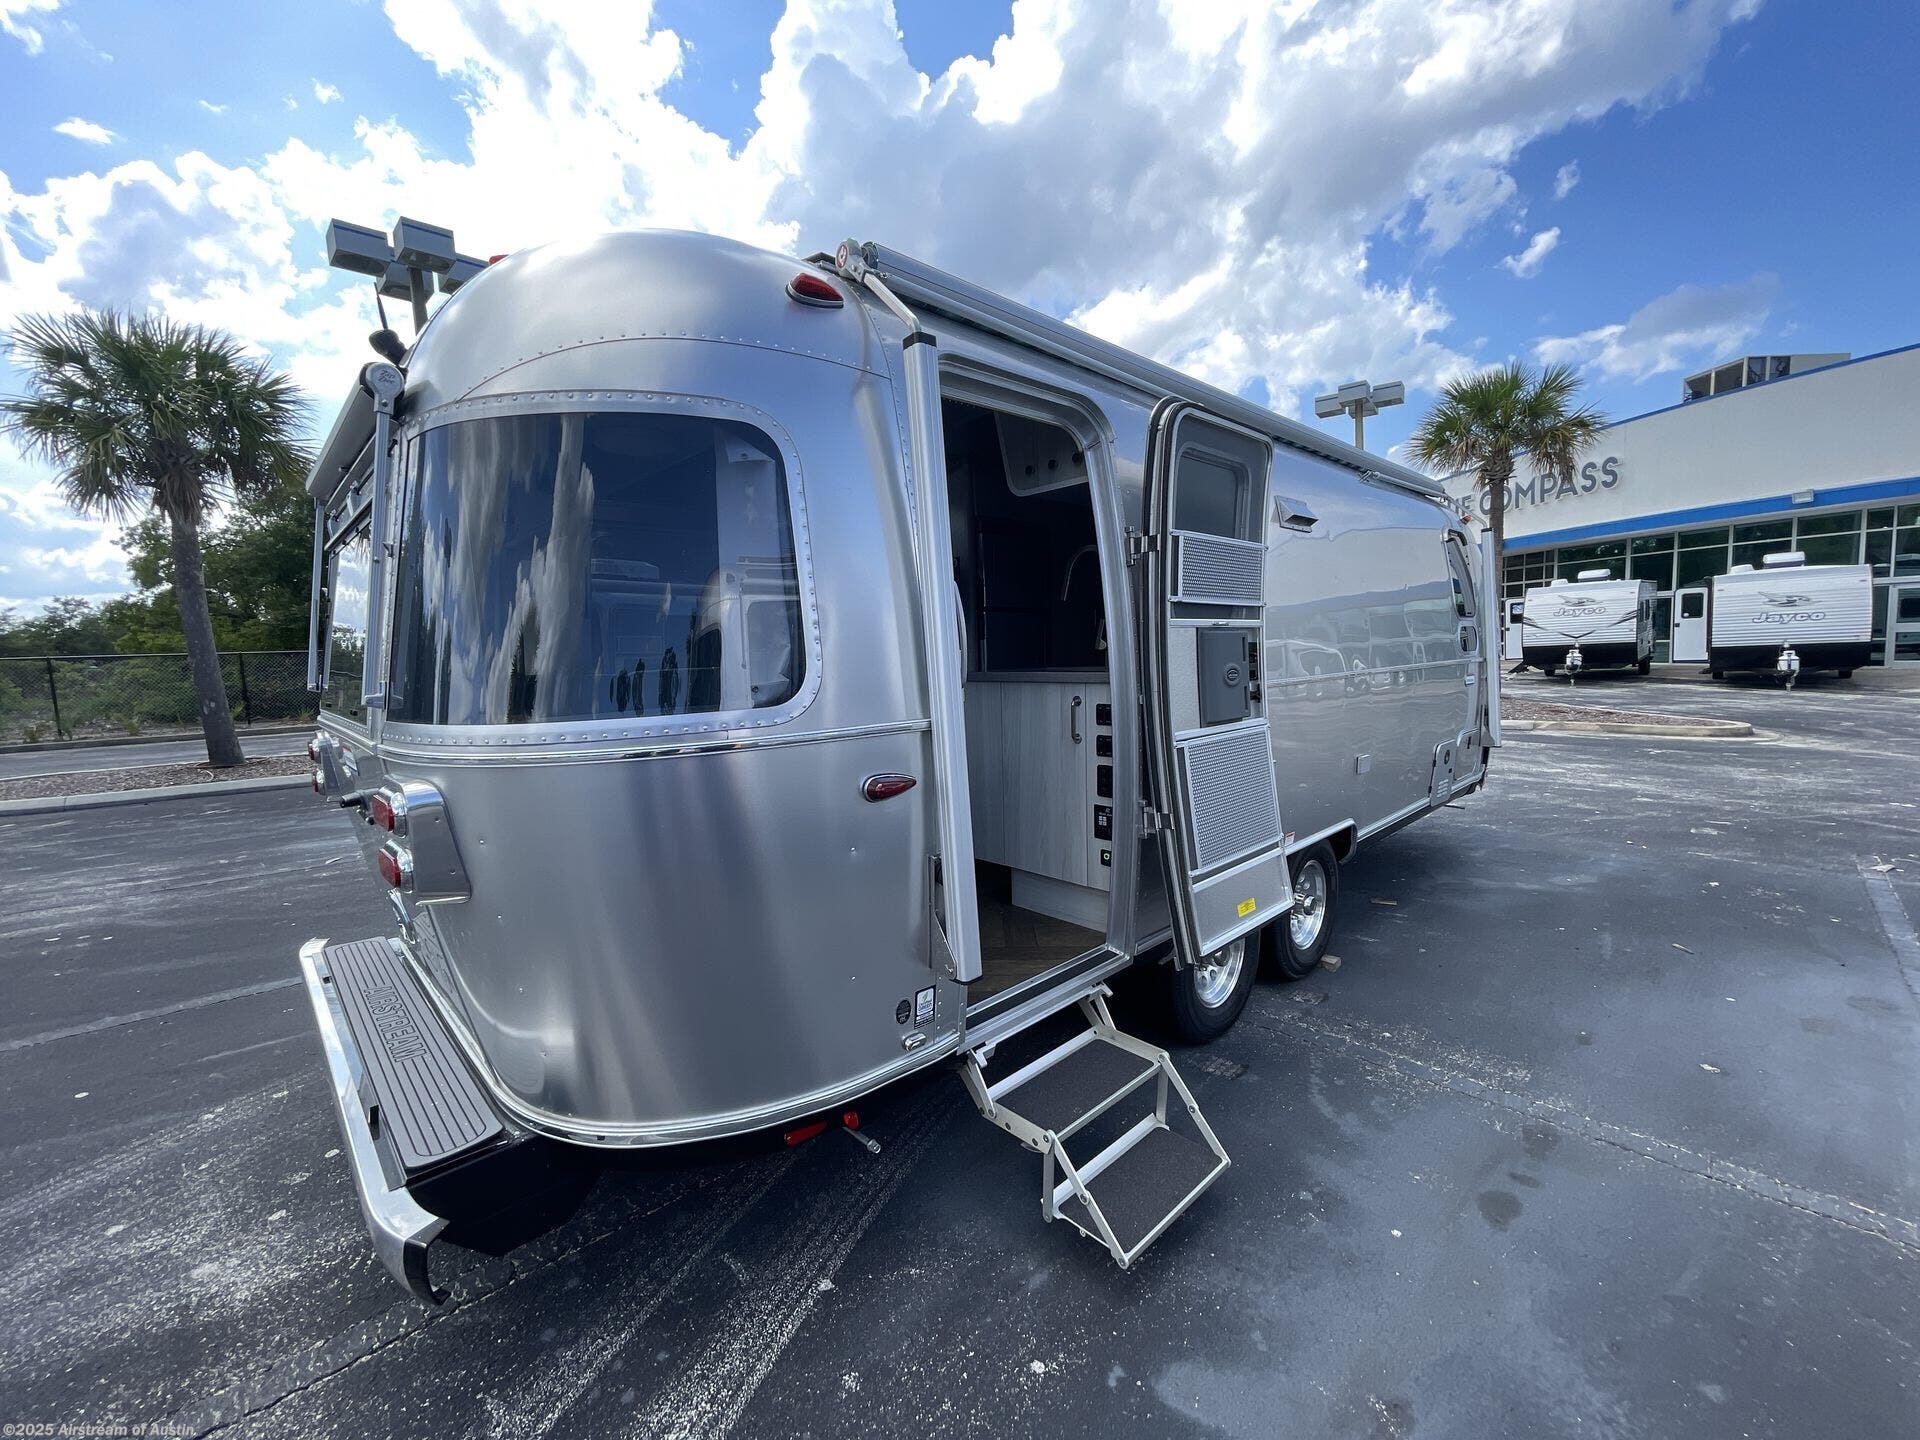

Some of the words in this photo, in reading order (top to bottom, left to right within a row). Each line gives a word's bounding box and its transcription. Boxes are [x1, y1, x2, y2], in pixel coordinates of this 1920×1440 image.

[1553, 606, 1607, 618] Jayco
[1752, 611, 1826, 625] Jayco
[363, 985, 427, 1063] AIRSTREAM
